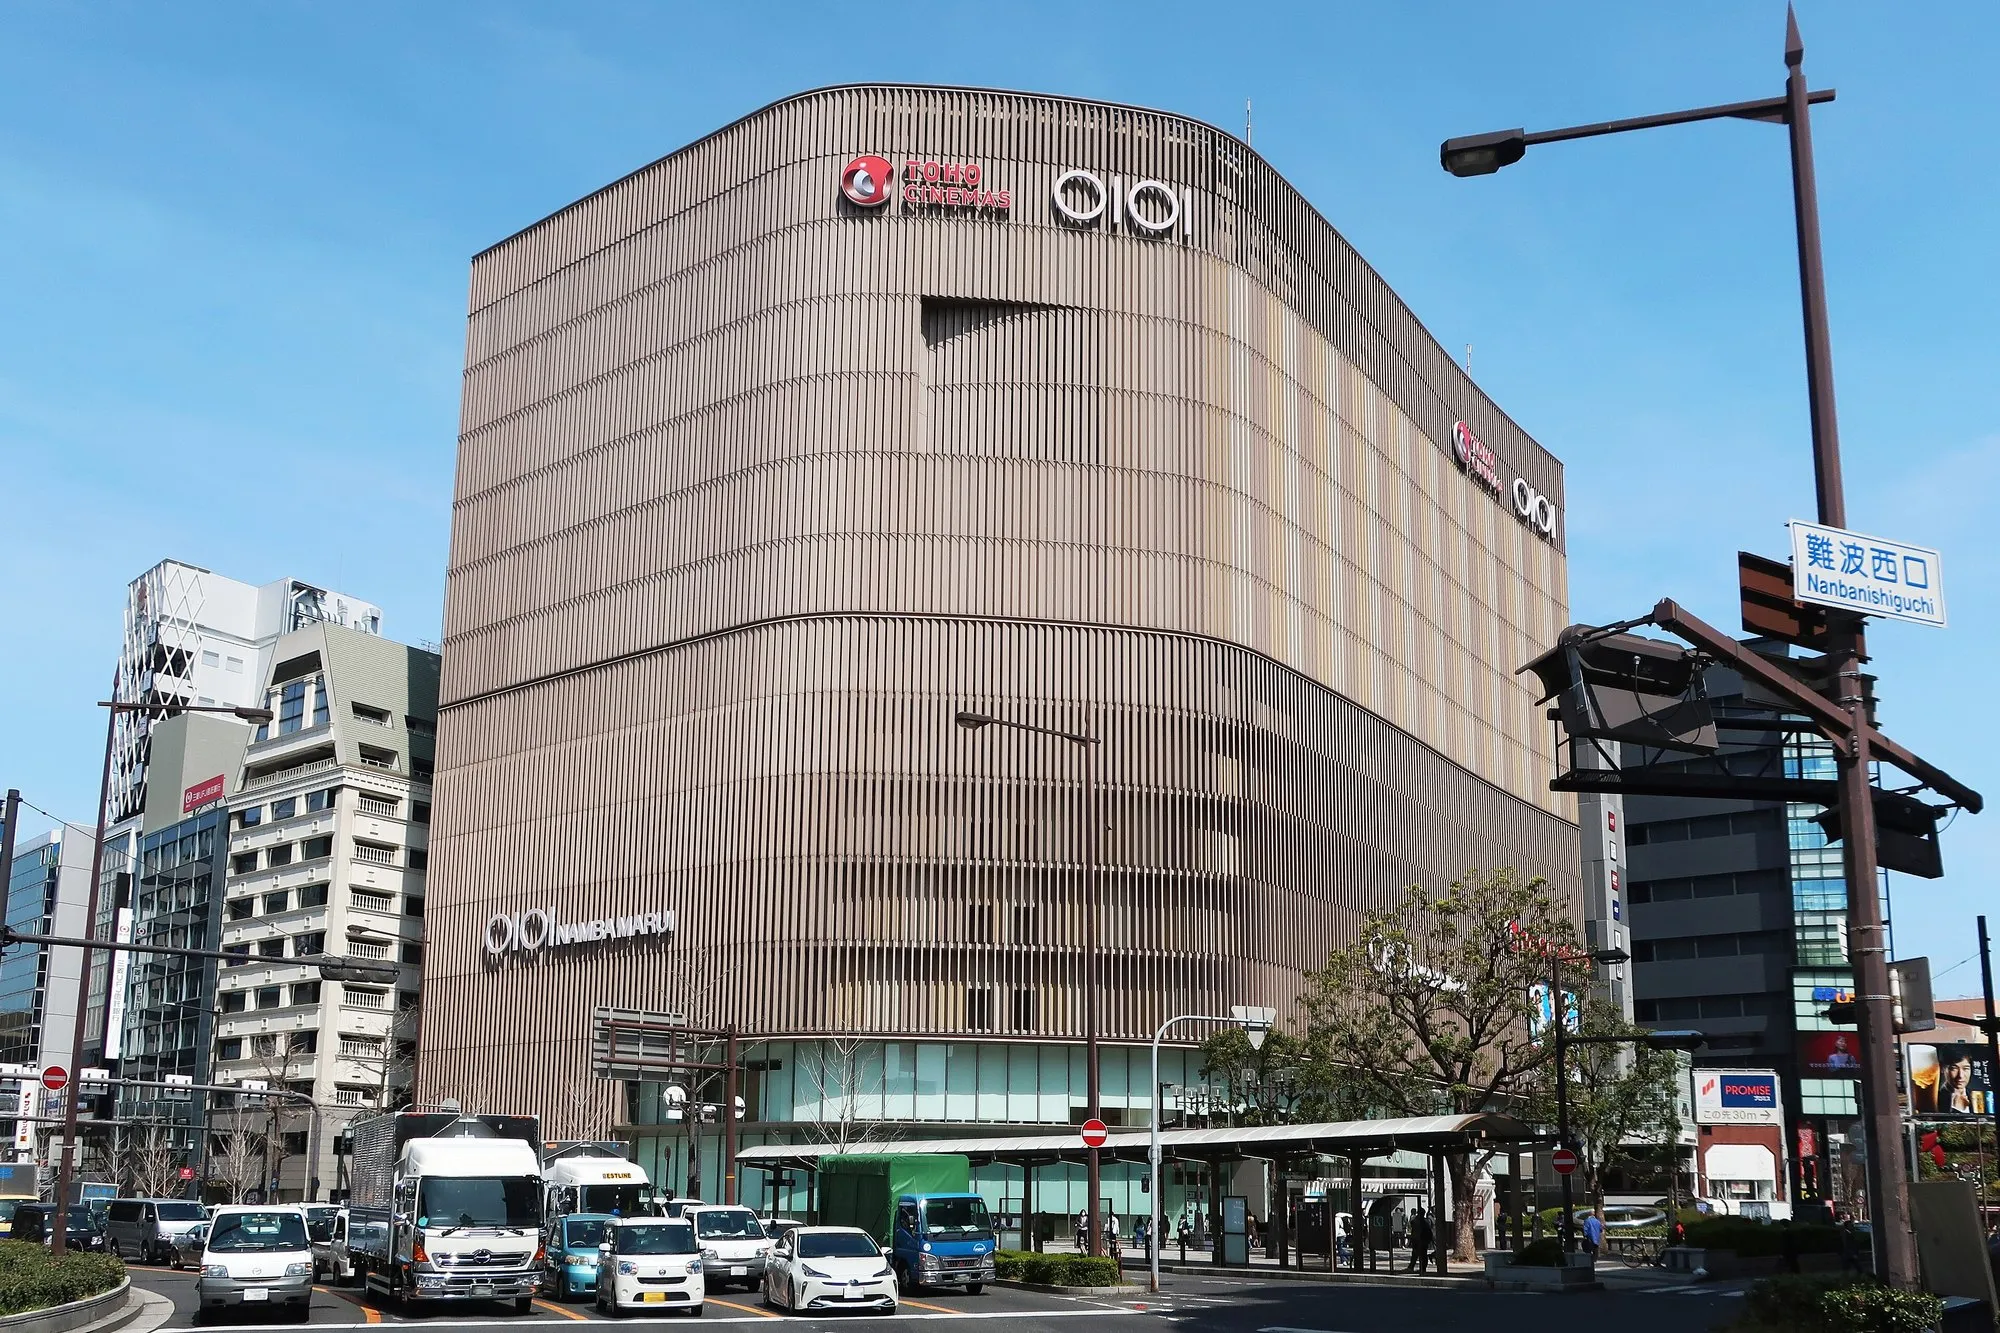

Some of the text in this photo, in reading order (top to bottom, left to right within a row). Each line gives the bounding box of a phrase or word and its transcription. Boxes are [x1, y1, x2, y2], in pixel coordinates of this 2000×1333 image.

[905, 160, 981, 185] TOHO
[904, 184, 1011, 208] CINEMAS
[1805, 533, 1928, 589] 難波西口
[1807, 573, 1935, 615] Nanbanishiguchi
[1725, 1085, 1771, 1096] PROMISE
[1703, 1110, 1757, 1120] この先30m
